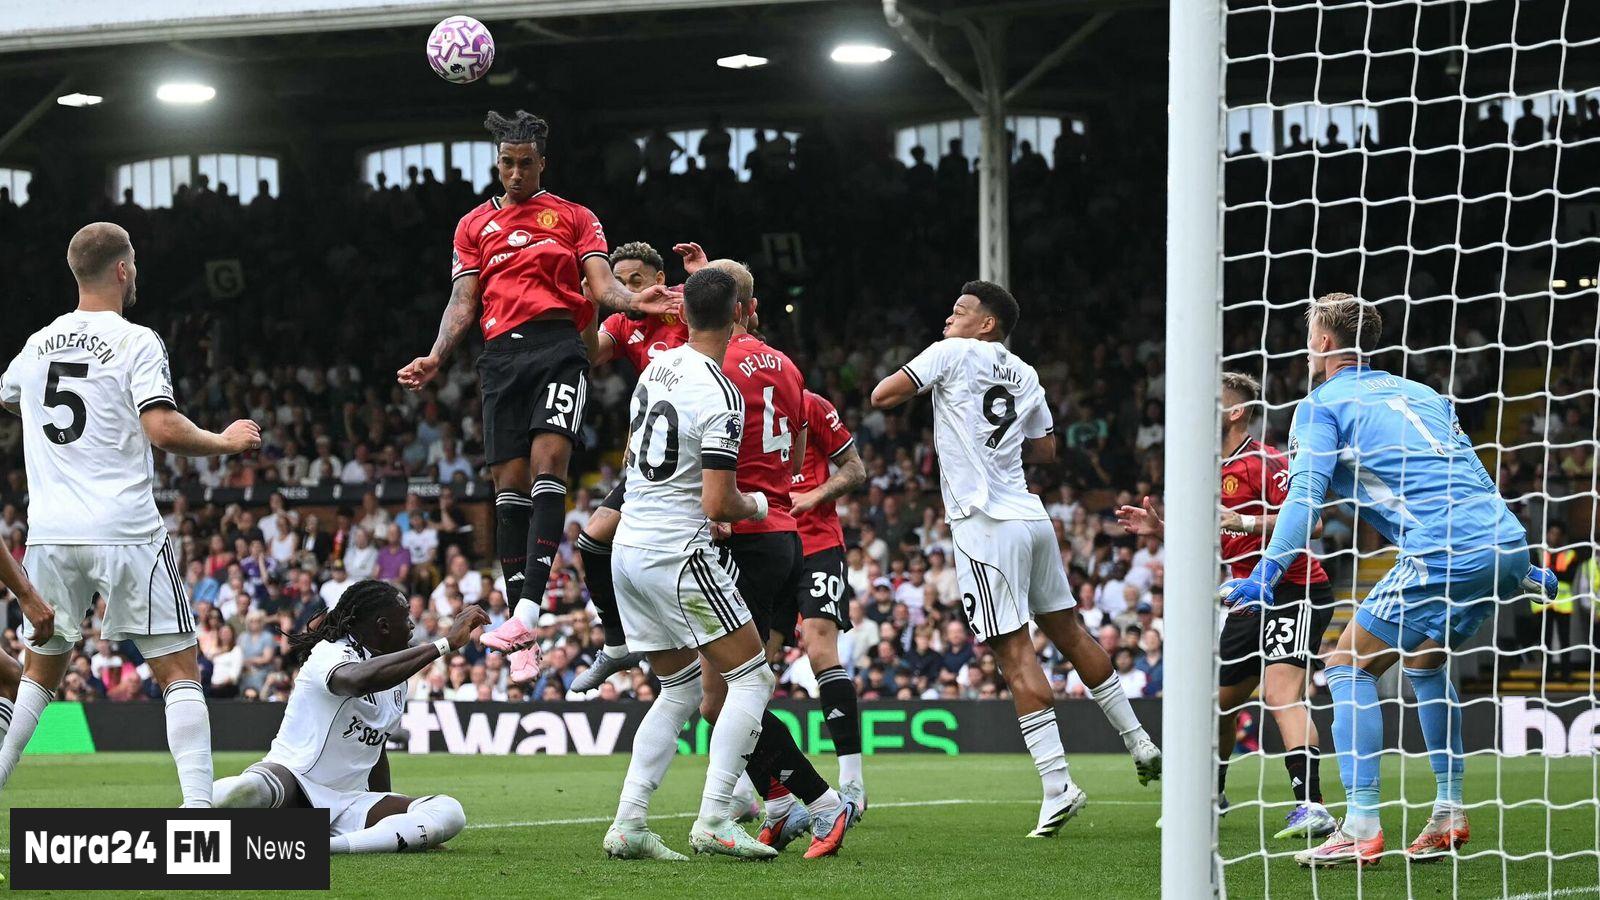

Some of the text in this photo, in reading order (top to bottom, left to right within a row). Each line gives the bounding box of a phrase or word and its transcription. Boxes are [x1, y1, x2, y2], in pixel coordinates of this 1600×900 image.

[37, 333, 116, 366] ANDERSEN
[738, 352, 783, 378] DE LIGT
[545, 382, 576, 414] 15
[649, 365, 684, 392] LUKIĆ
[42, 361, 89, 445] 5
[762, 386, 792, 463] 4
[982, 384, 1018, 450] 9
[626, 383, 679, 482] 20
[1384, 396, 1447, 456] 1
[810, 571, 841, 600] 30
[1264, 617, 1296, 648] 23
[386, 700, 627, 756] tway
